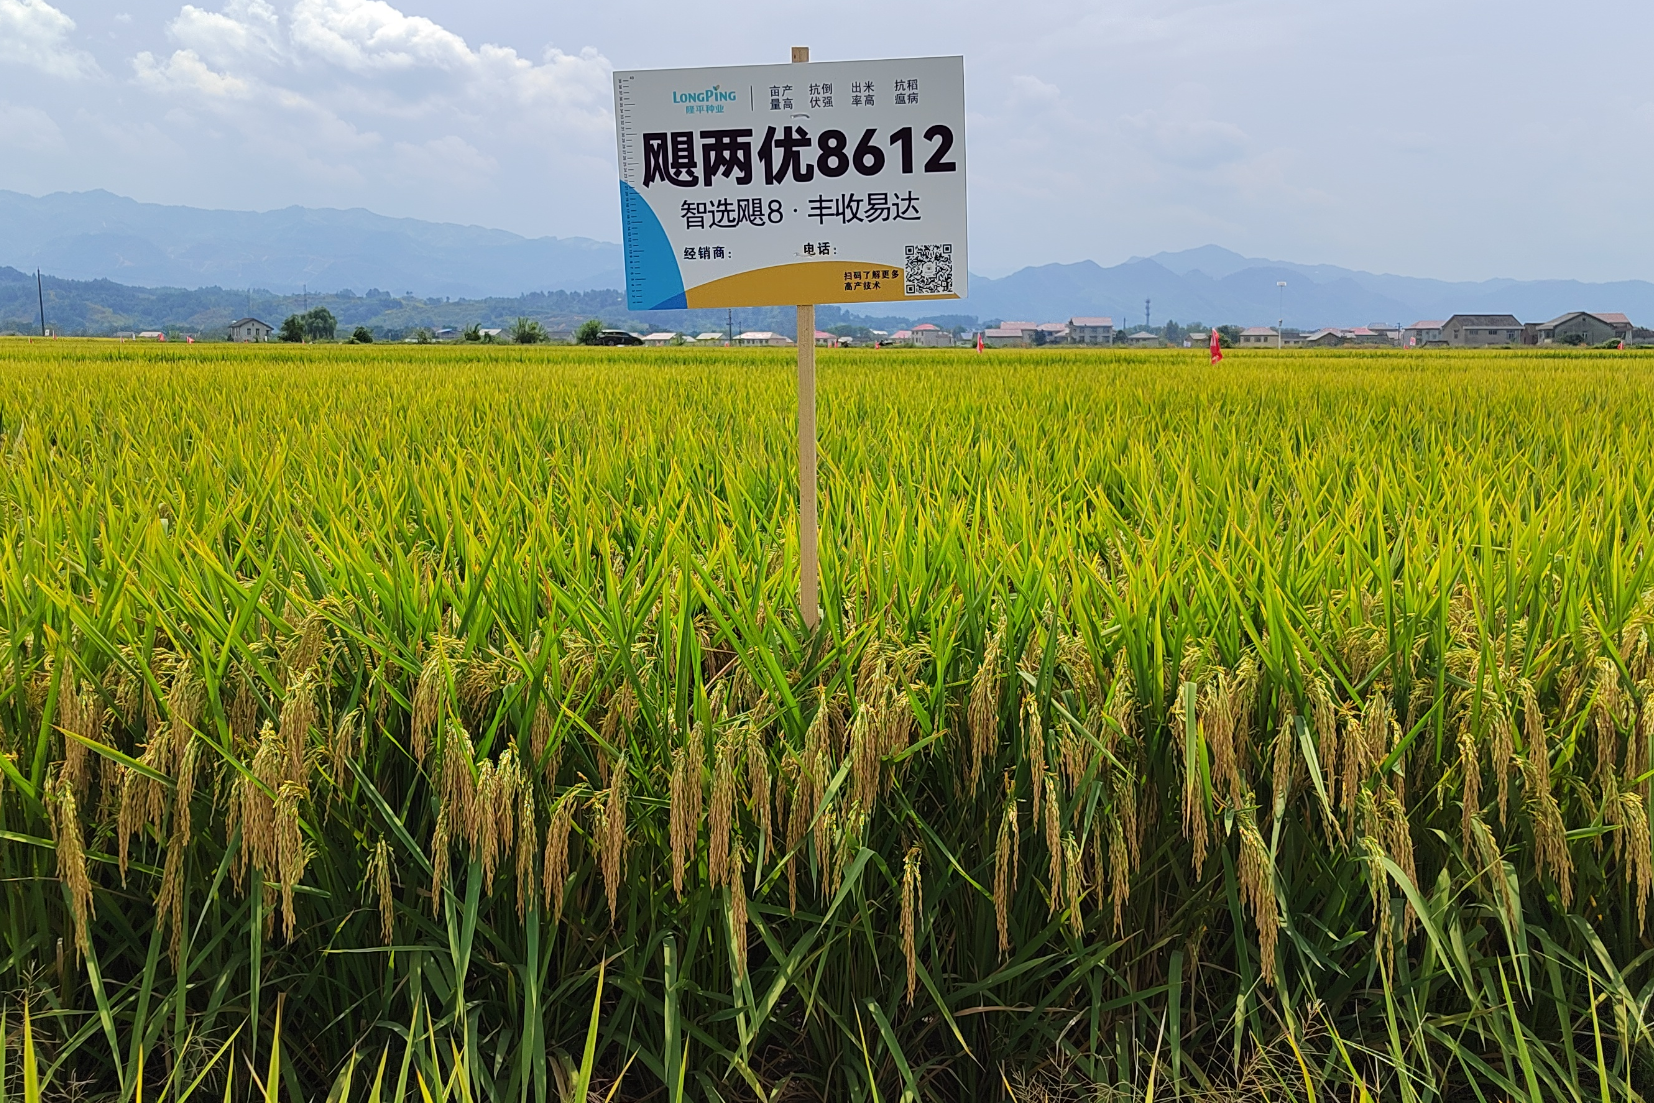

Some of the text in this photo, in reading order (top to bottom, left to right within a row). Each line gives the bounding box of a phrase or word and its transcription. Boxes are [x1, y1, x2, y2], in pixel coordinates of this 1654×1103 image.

[769, 79, 918, 97] 亩产 抗倒 出米 抗稻
[769, 92, 919, 110] 量高 伏强 率高 瘟病
[685, 105, 724, 114] 隆平种业
[643, 125, 957, 188] 飓两优8612
[844, 269, 899, 281] 扫码了解更多
[844, 281, 881, 291] 高产技术
